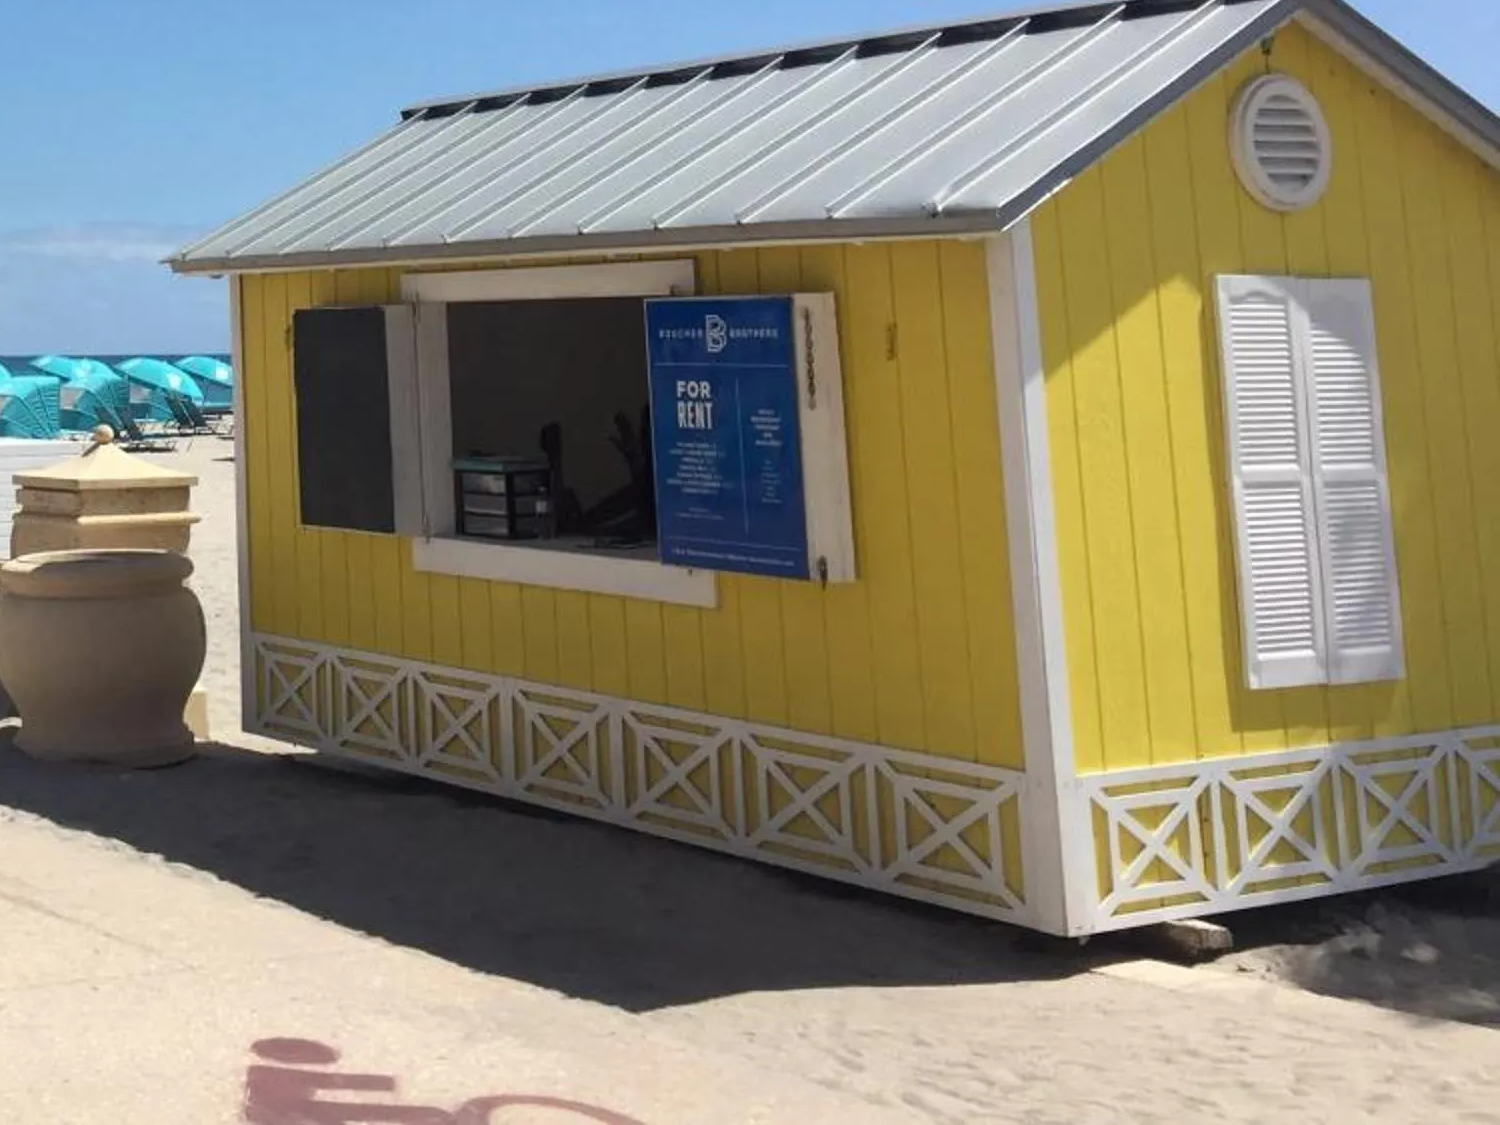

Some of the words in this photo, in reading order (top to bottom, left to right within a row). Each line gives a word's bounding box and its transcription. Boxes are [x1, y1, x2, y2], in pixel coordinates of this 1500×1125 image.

[729, 327, 779, 339] BROTHERS
[676, 380, 711, 399] FOR
[677, 401, 713, 430] RENT
